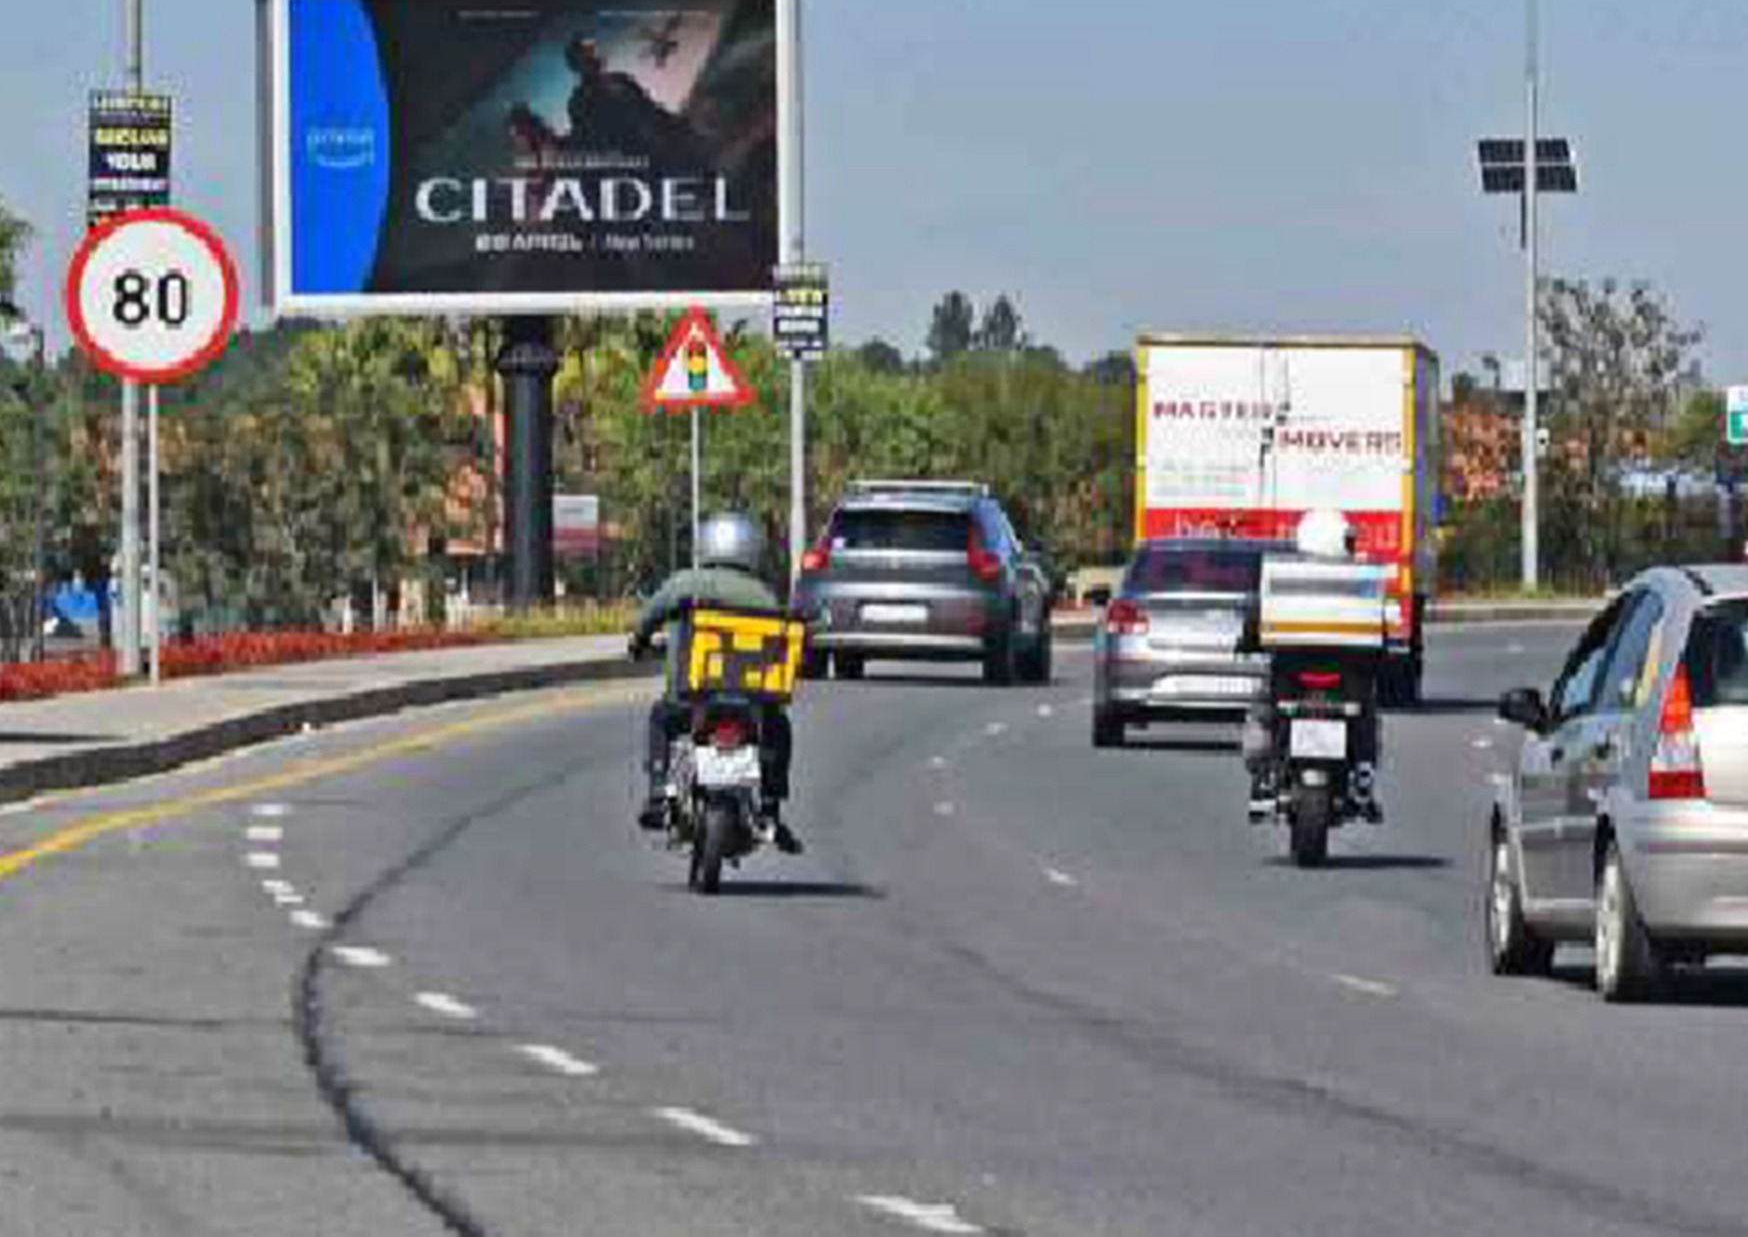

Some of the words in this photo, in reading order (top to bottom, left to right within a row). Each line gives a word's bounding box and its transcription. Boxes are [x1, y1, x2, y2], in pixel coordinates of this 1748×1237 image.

[414, 177, 750, 222] CITADEL
[112, 271, 187, 326] 80
[1278, 430, 1402, 454] MOVERS
